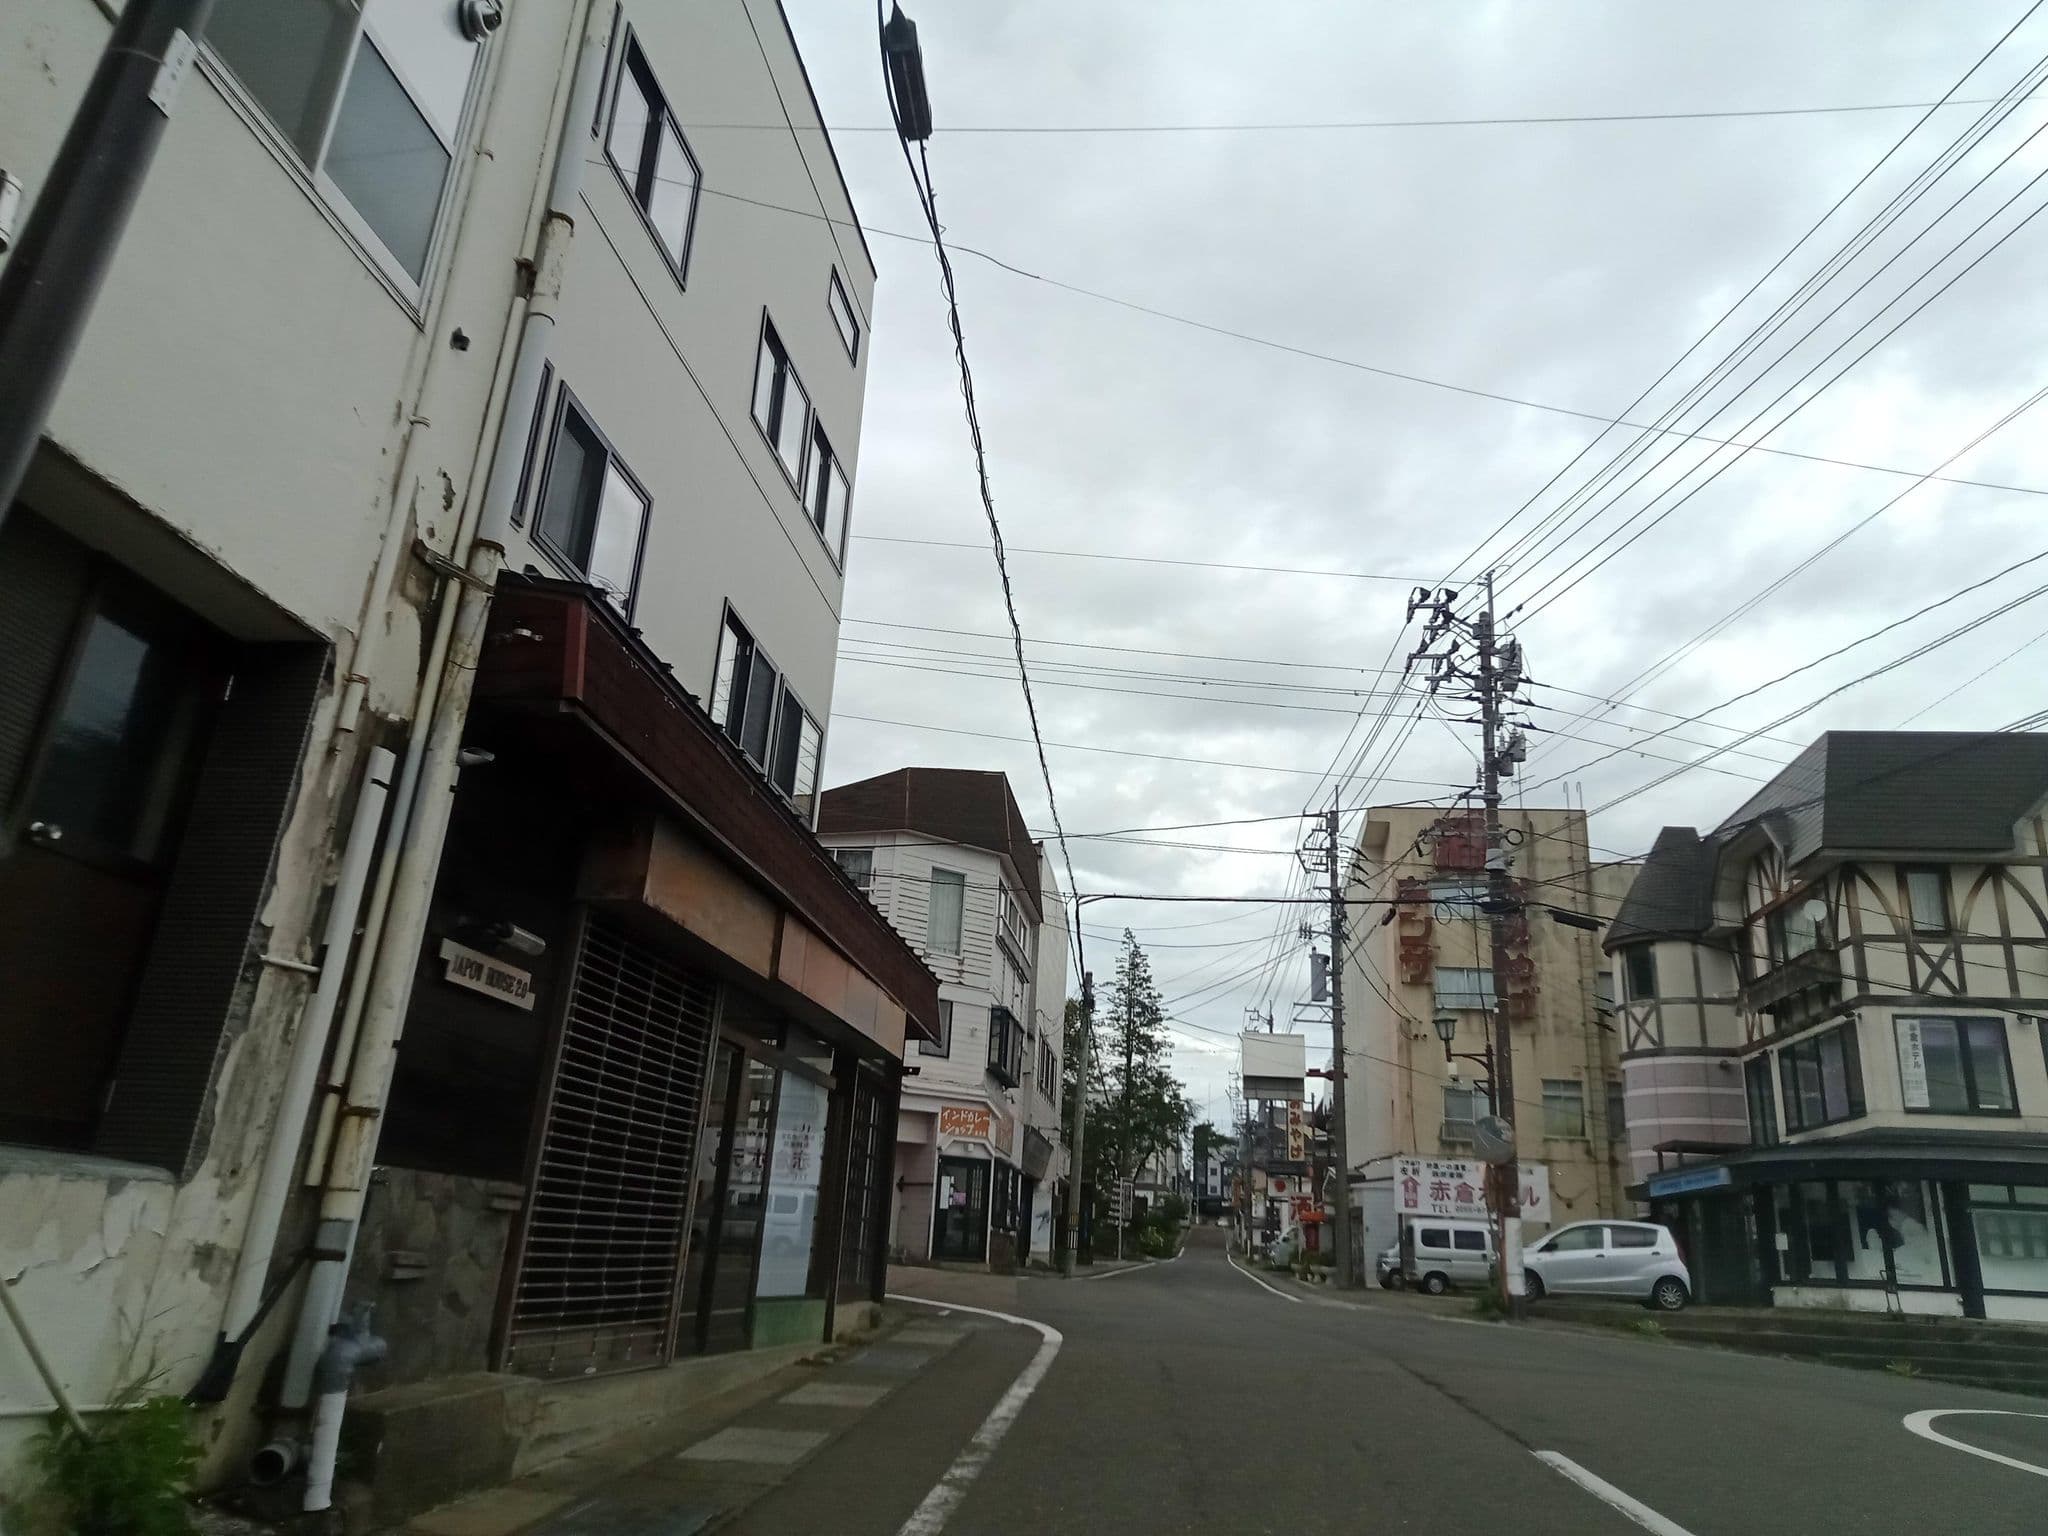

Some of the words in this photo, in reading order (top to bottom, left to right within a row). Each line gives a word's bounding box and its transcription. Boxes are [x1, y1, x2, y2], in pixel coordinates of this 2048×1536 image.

[942, 1109, 990, 1122] インドカレー
